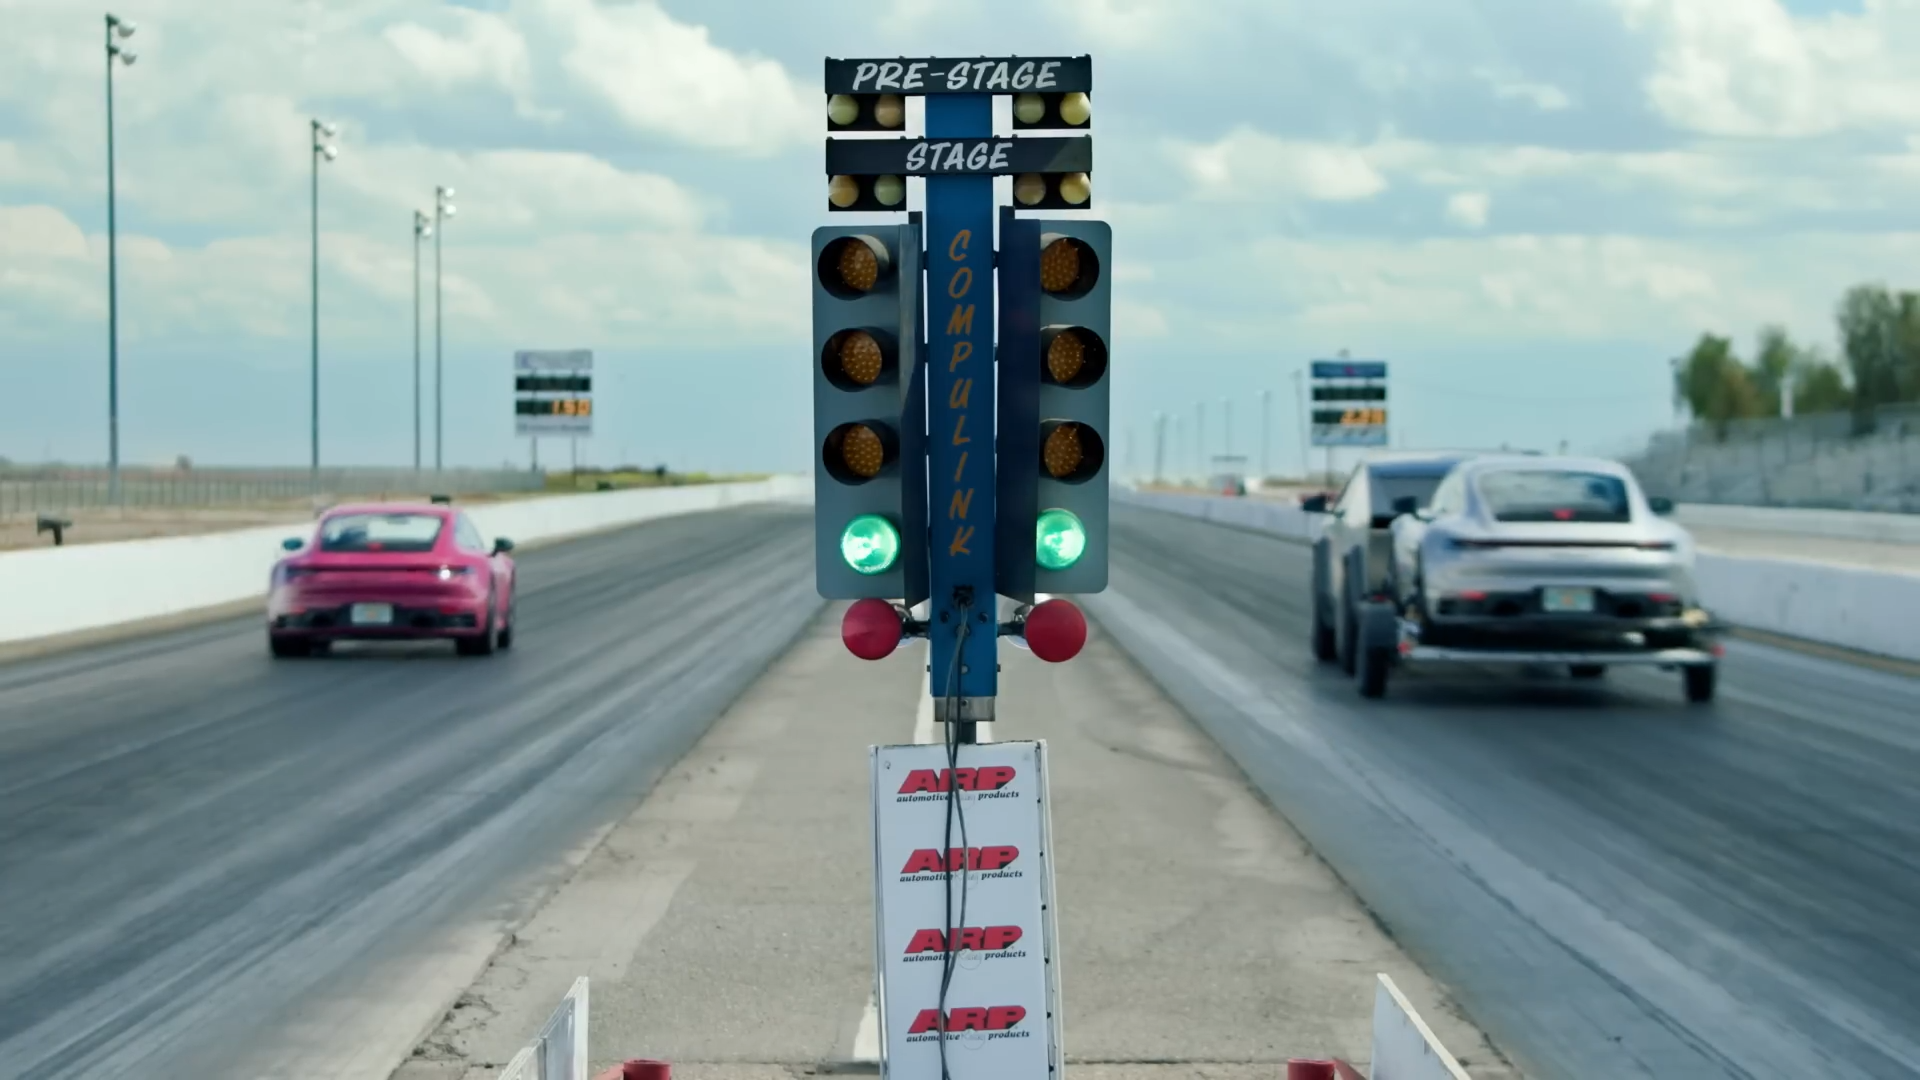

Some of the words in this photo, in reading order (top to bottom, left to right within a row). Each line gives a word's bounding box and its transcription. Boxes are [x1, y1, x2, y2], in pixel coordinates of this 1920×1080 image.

[852, 61, 1061, 91] PRE-STAGE
[906, 142, 1013, 171] STAGE
[946, 229, 975, 557] COMPULINK
[897, 765, 1016, 794] ARP
[978, 790, 1019, 801] products
[900, 845, 1020, 874] ARP
[981, 870, 1023, 881] products
[903, 925, 1023, 954] ARP
[984, 949, 1026, 961] products
[907, 1005, 1026, 1034] ARP
[988, 1030, 1030, 1041] products
